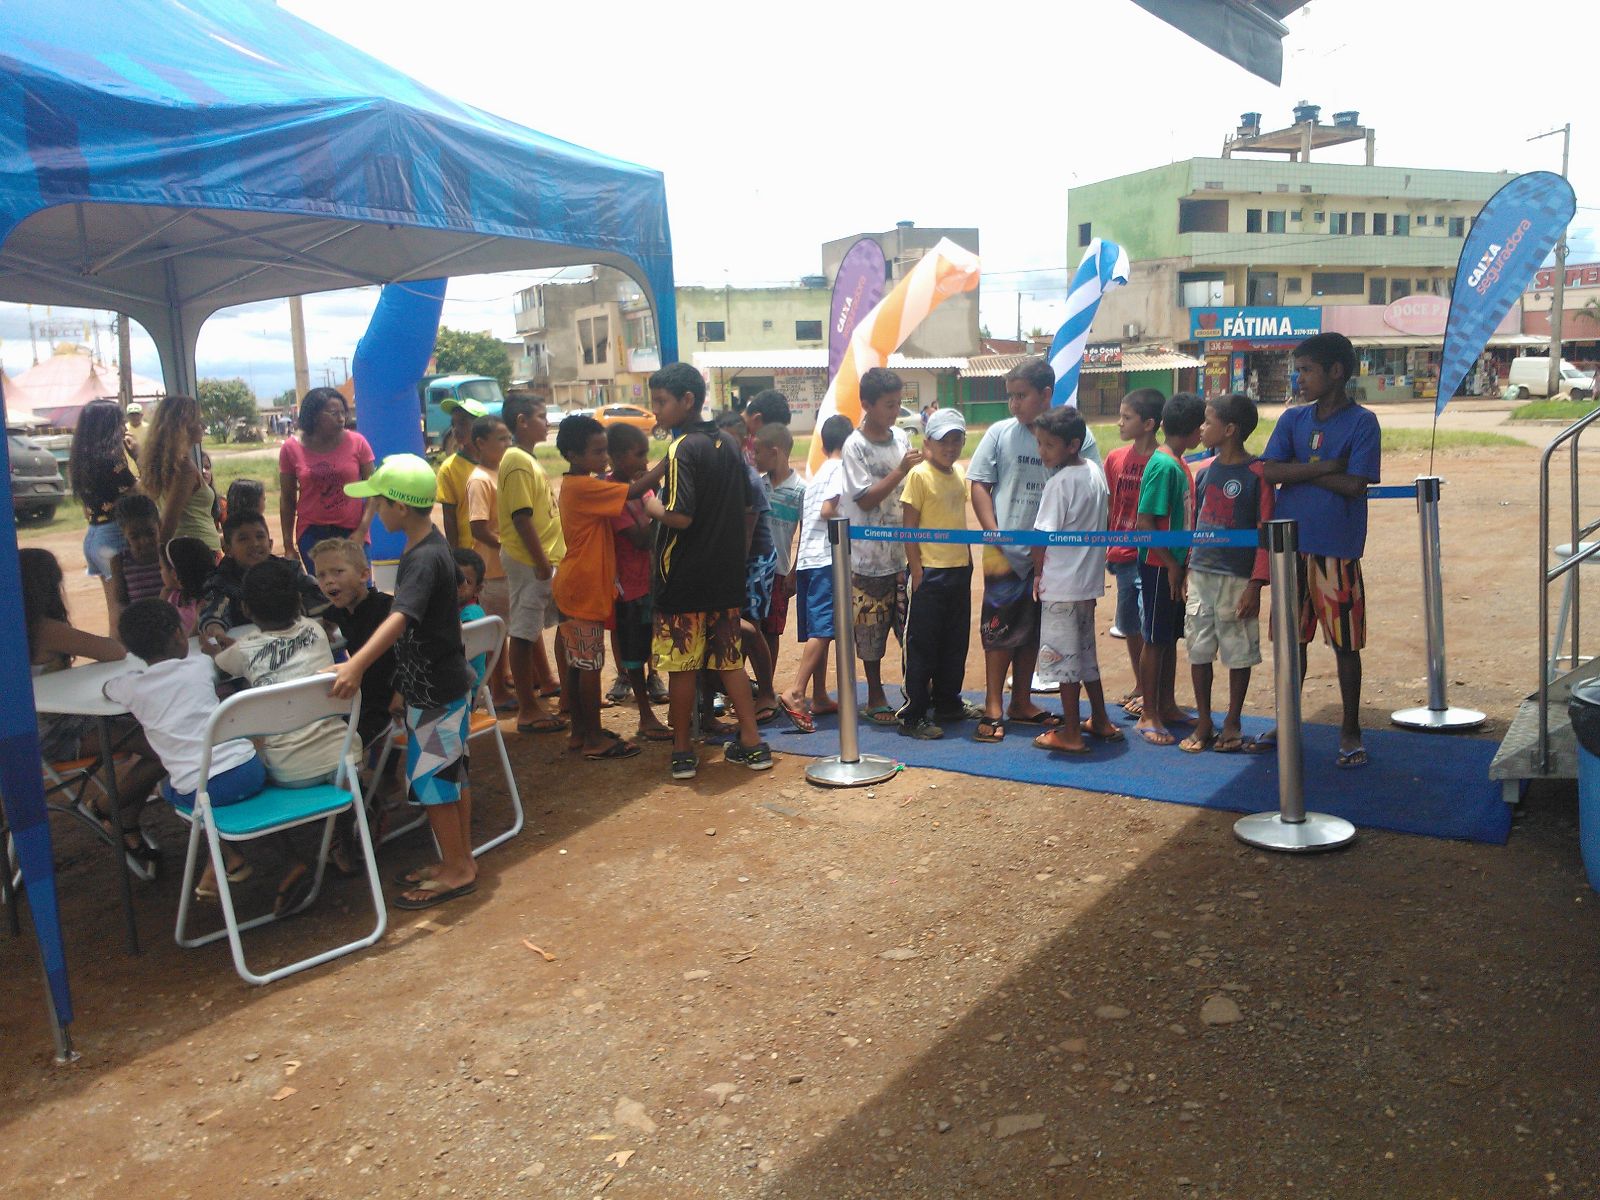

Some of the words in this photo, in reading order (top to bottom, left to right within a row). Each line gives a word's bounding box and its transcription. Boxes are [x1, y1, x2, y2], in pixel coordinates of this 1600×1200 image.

[1468, 244, 1501, 287] CAIXA
[1476, 219, 1532, 295] seguradora
[837, 296, 853, 333] CAIXA
[1393, 303, 1428, 317] DOCE
[1223, 311, 1292, 337] FÁTIMA
[864, 528, 892, 538] Cinema
[899, 531, 912, 540] pra
[1048, 533, 1082, 543] Cinema
[1091, 535, 1106, 544] pra
